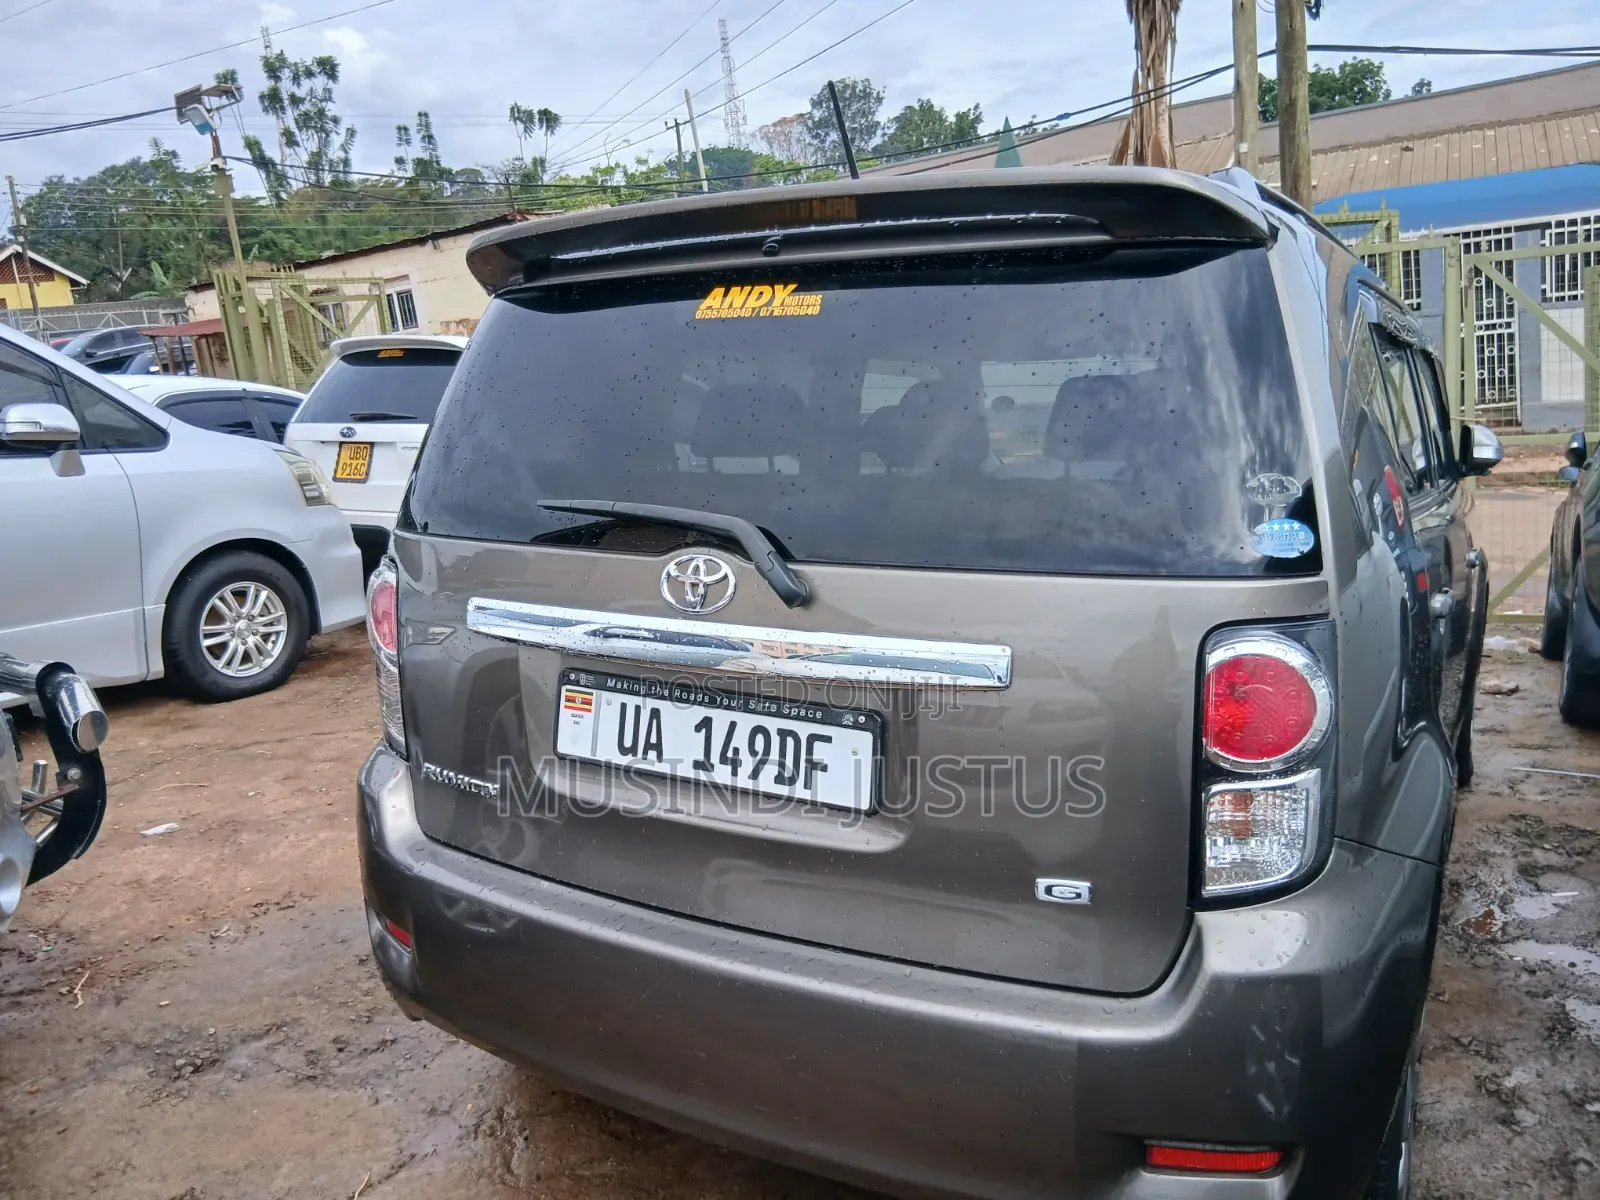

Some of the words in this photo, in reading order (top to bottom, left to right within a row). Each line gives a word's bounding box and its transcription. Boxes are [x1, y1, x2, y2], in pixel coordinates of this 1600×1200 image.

[698, 283, 799, 310] ANDY
[783, 294, 823, 307] MOTORS
[340, 462, 366, 477] 916C
[606, 678, 646, 695] Making
[651, 685, 670, 697] the
[674, 688, 710, 703] Roads
[715, 695, 744, 707] Your
[748, 699, 777, 712] Safe
[782, 704, 823, 719] Space
[617, 701, 664, 763] UA
[692, 715, 833, 790] 149DF
